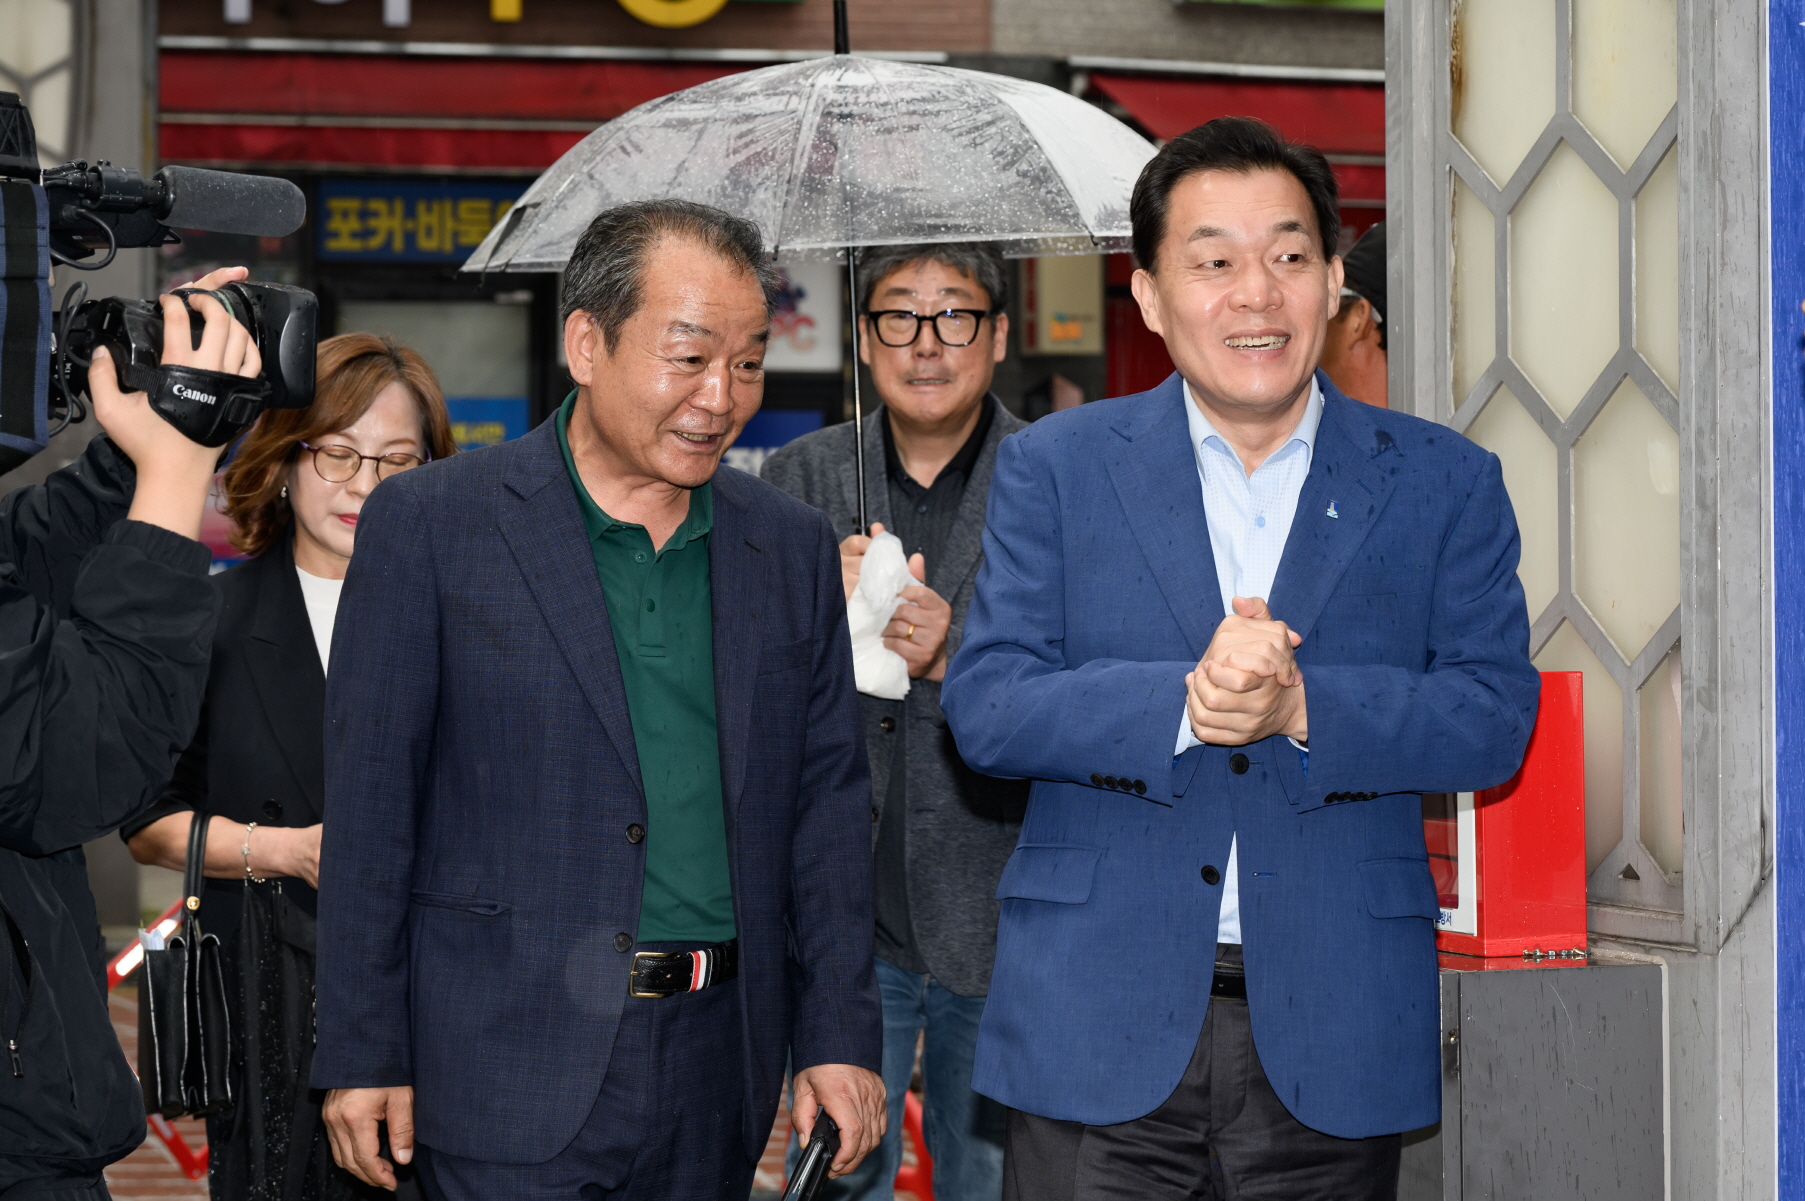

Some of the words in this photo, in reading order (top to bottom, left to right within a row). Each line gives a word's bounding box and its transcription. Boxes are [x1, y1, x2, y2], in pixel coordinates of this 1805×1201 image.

[325, 198, 514, 254] 포커·바둑
[172, 384, 217, 405] Canon
[1435, 911, 1452, 926] 방서
